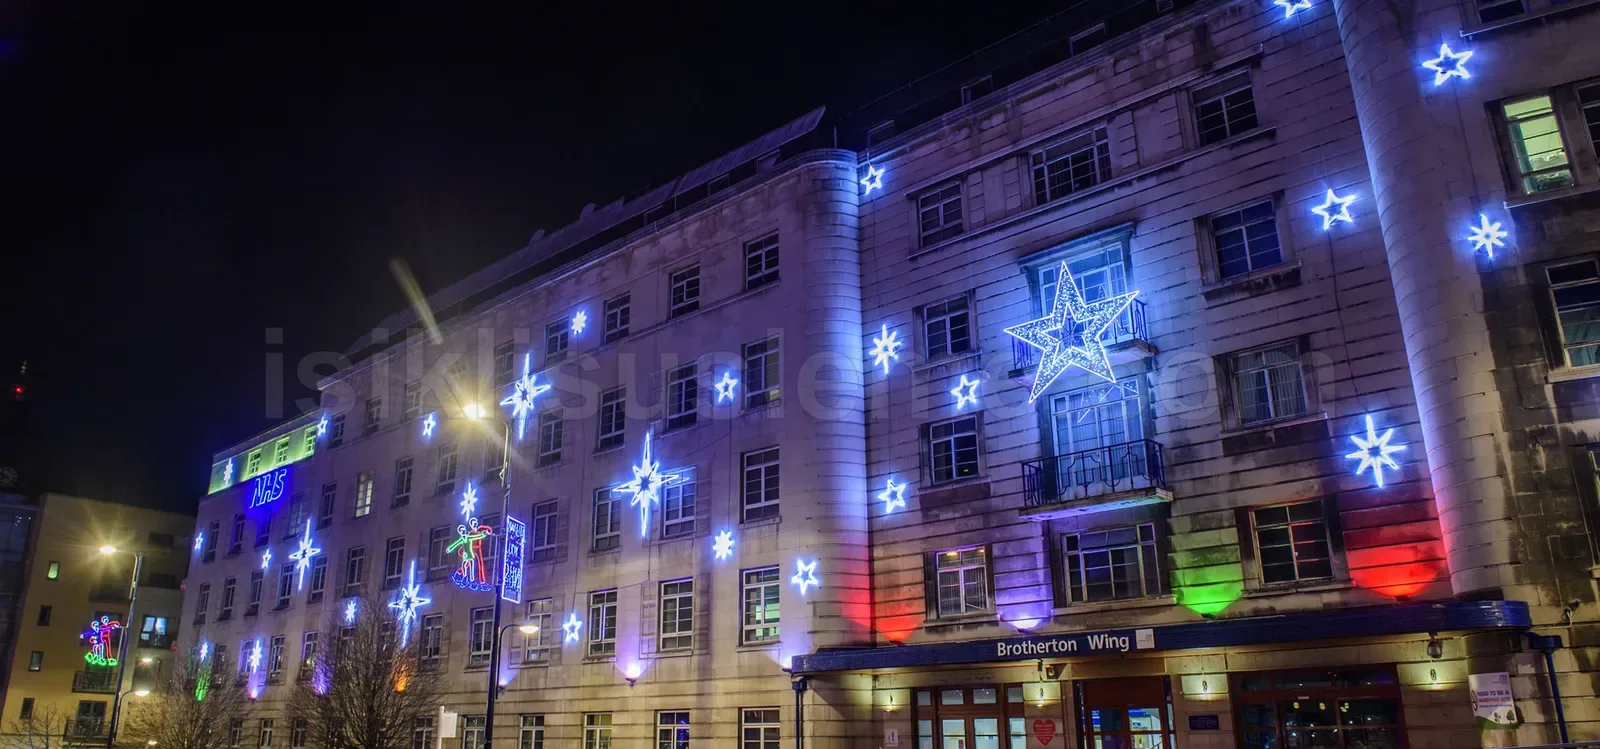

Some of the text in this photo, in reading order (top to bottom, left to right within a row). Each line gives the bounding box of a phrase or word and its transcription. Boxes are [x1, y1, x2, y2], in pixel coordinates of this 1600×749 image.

[249, 469, 287, 508] NHS
[997, 634, 1129, 656] Brotherton Wing
